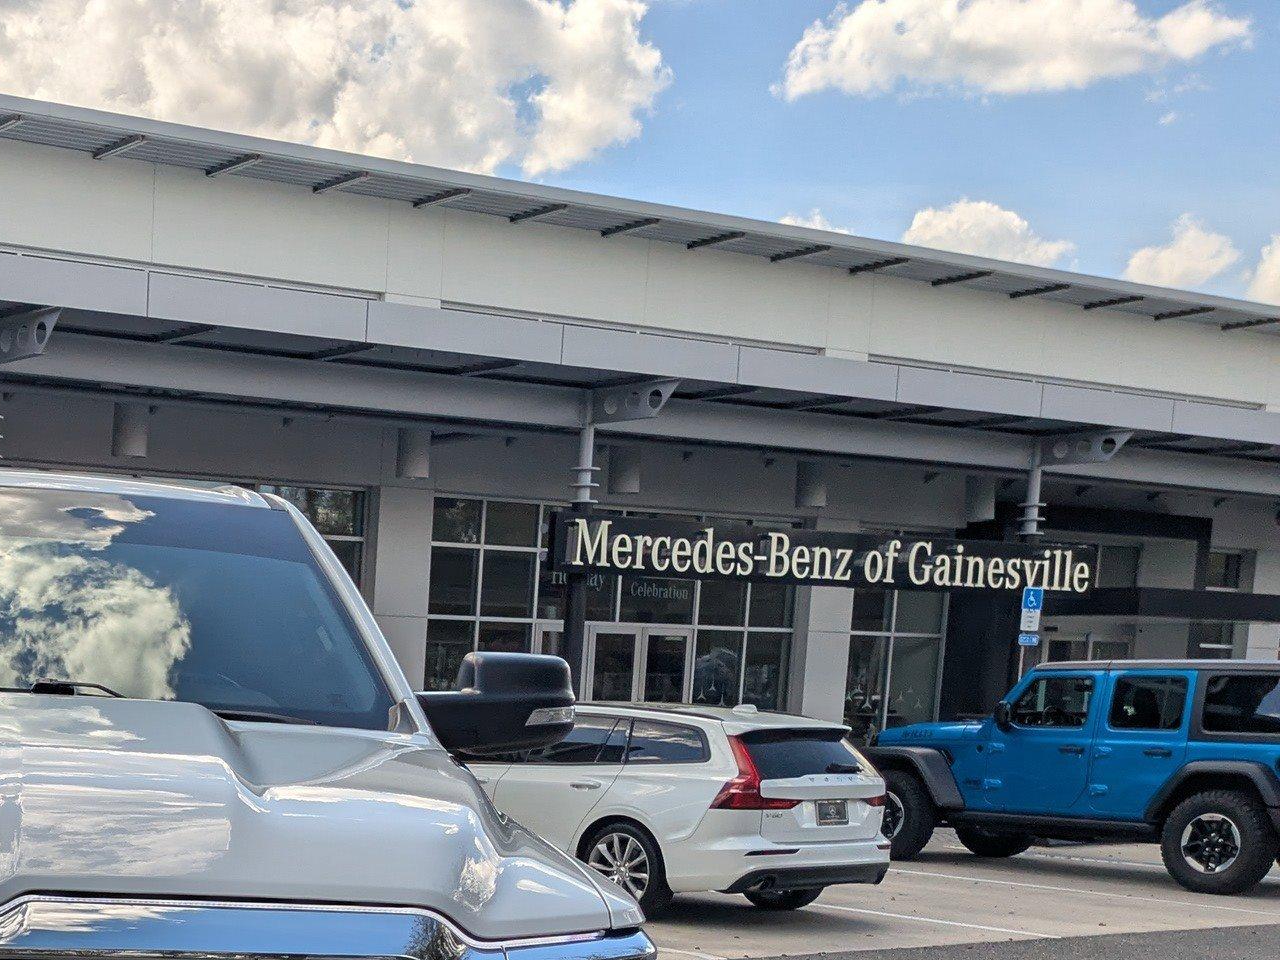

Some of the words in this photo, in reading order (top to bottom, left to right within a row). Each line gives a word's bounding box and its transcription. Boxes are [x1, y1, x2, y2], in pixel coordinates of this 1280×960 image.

[572, 518, 852, 581] Mercedes-Benz
[864, 540, 901, 583] of
[908, 541, 1090, 592] Gainesville
[631, 580, 689, 600] Celebration
